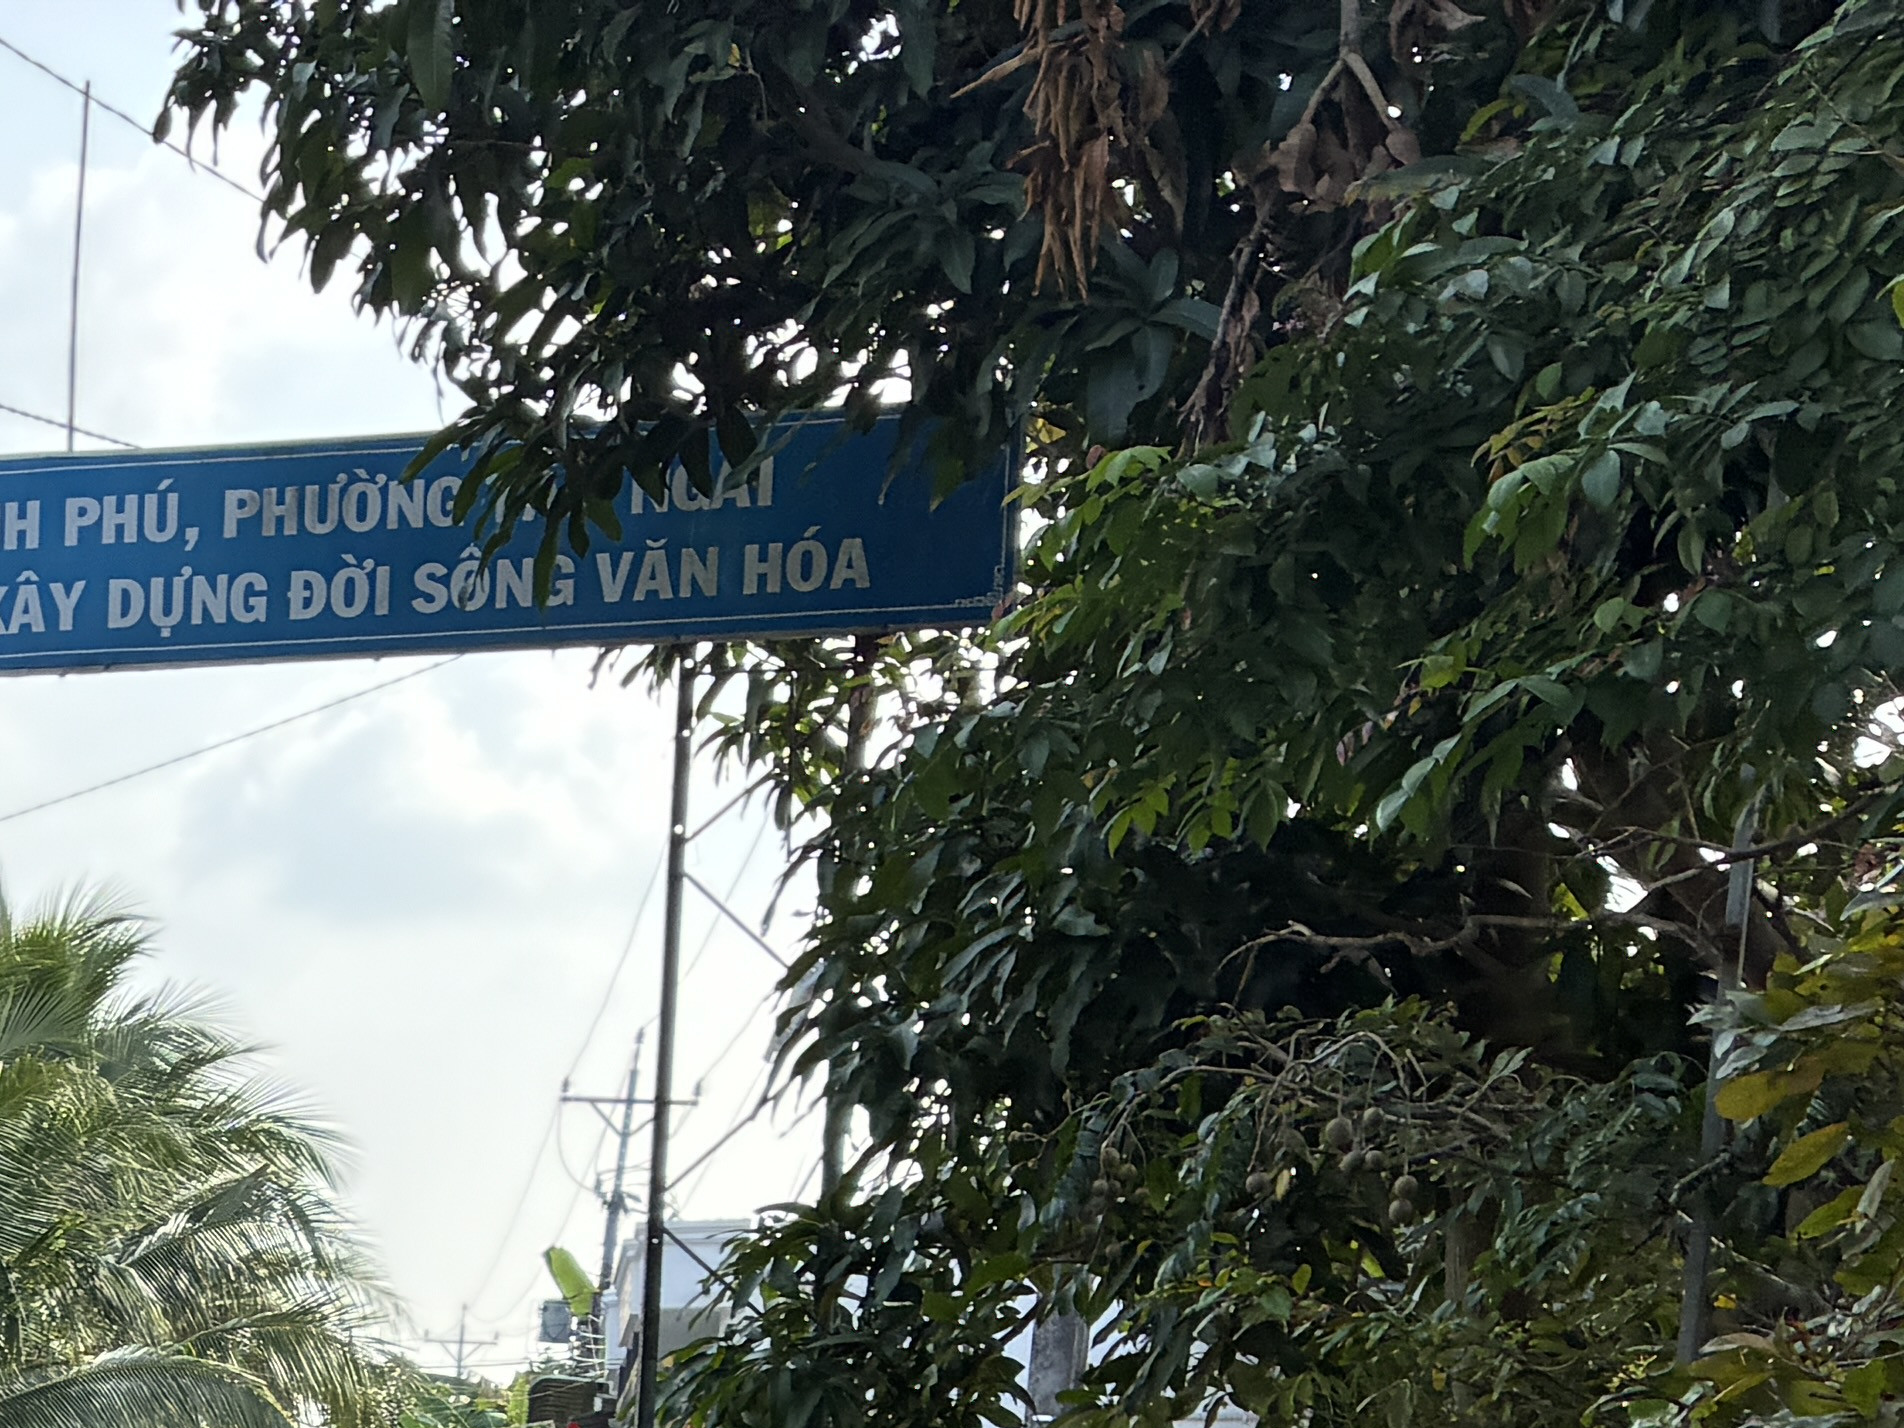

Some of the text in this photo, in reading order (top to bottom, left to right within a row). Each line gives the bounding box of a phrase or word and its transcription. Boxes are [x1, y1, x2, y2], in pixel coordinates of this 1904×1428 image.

[64, 478, 200, 552] PHÚ,
[222, 467, 464, 539] PHƯỜNG
[106, 565, 267, 638] DỰNG
[287, 553, 392, 620] ĐỜI
[595, 537, 720, 602] VĂN
[742, 524, 871, 596] HÓA
